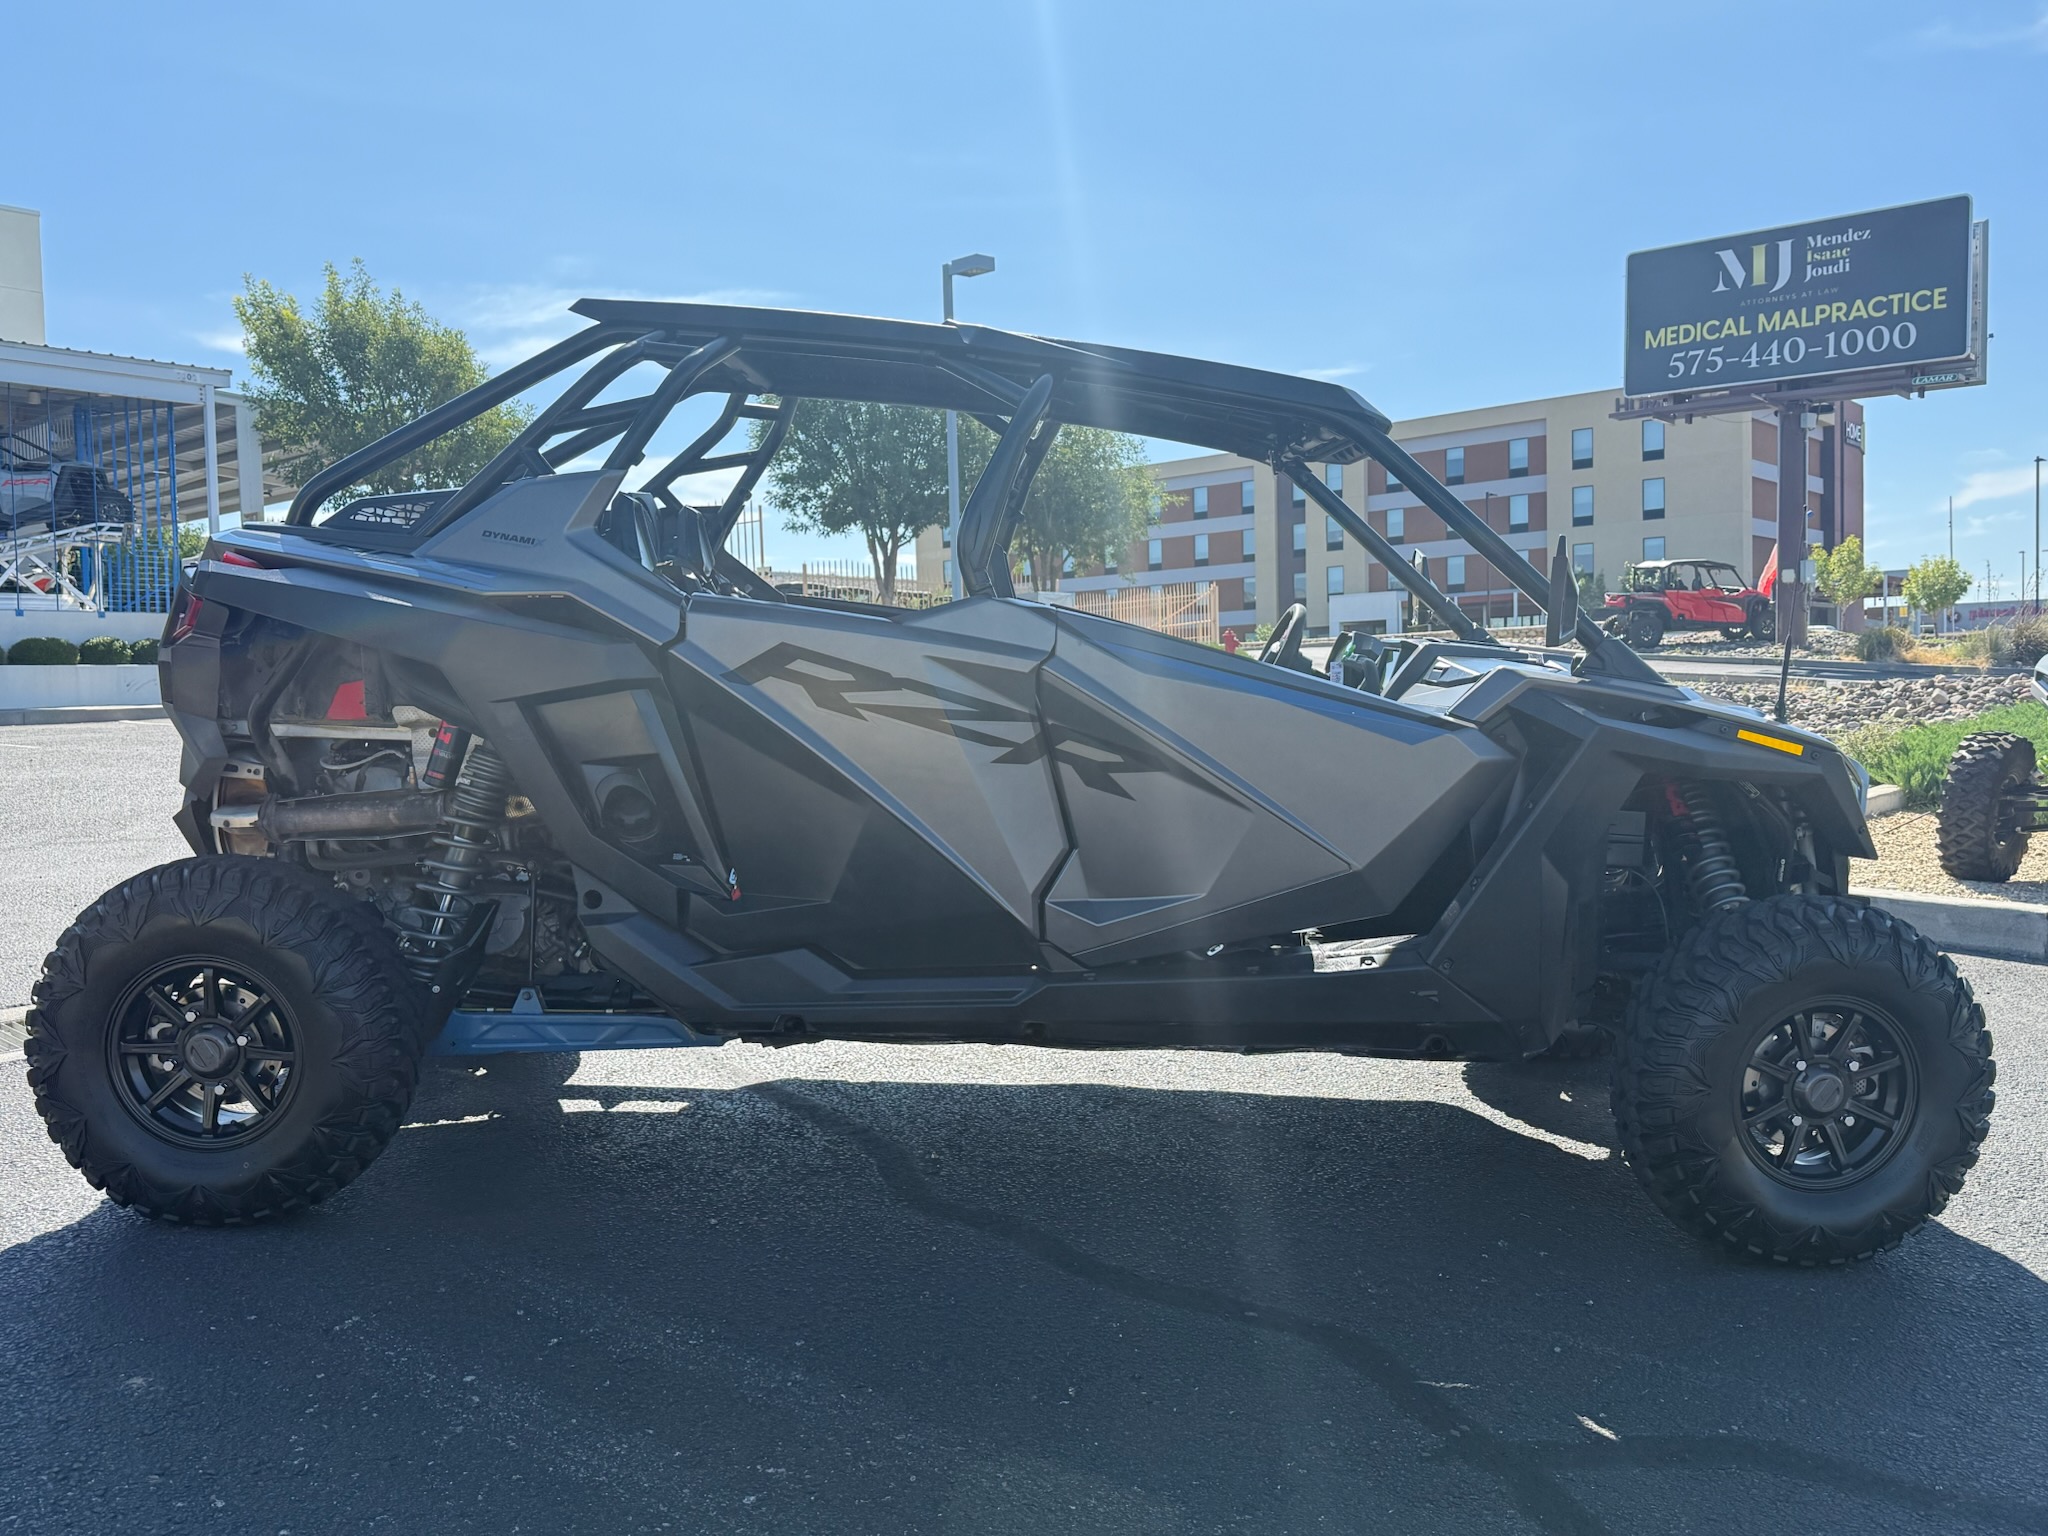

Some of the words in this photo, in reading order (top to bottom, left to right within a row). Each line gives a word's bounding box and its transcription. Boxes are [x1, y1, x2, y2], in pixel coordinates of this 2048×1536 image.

[1806, 228, 1872, 249] Mendez
[1806, 247, 1851, 263] Isaac
[1803, 258, 1850, 283] Joudi
[1739, 293, 1798, 307] ATTORNEYS
[1801, 290, 1813, 299] AT
[1817, 287, 1840, 297] LAW
[1644, 316, 1752, 350] MEDICAL
[1757, 287, 1948, 333] MALPRACTICE
[1667, 321, 1918, 379] 575-440-1000
[1914, 374, 1955, 385] LAMAR
[719, 641, 1171, 802] RZR
